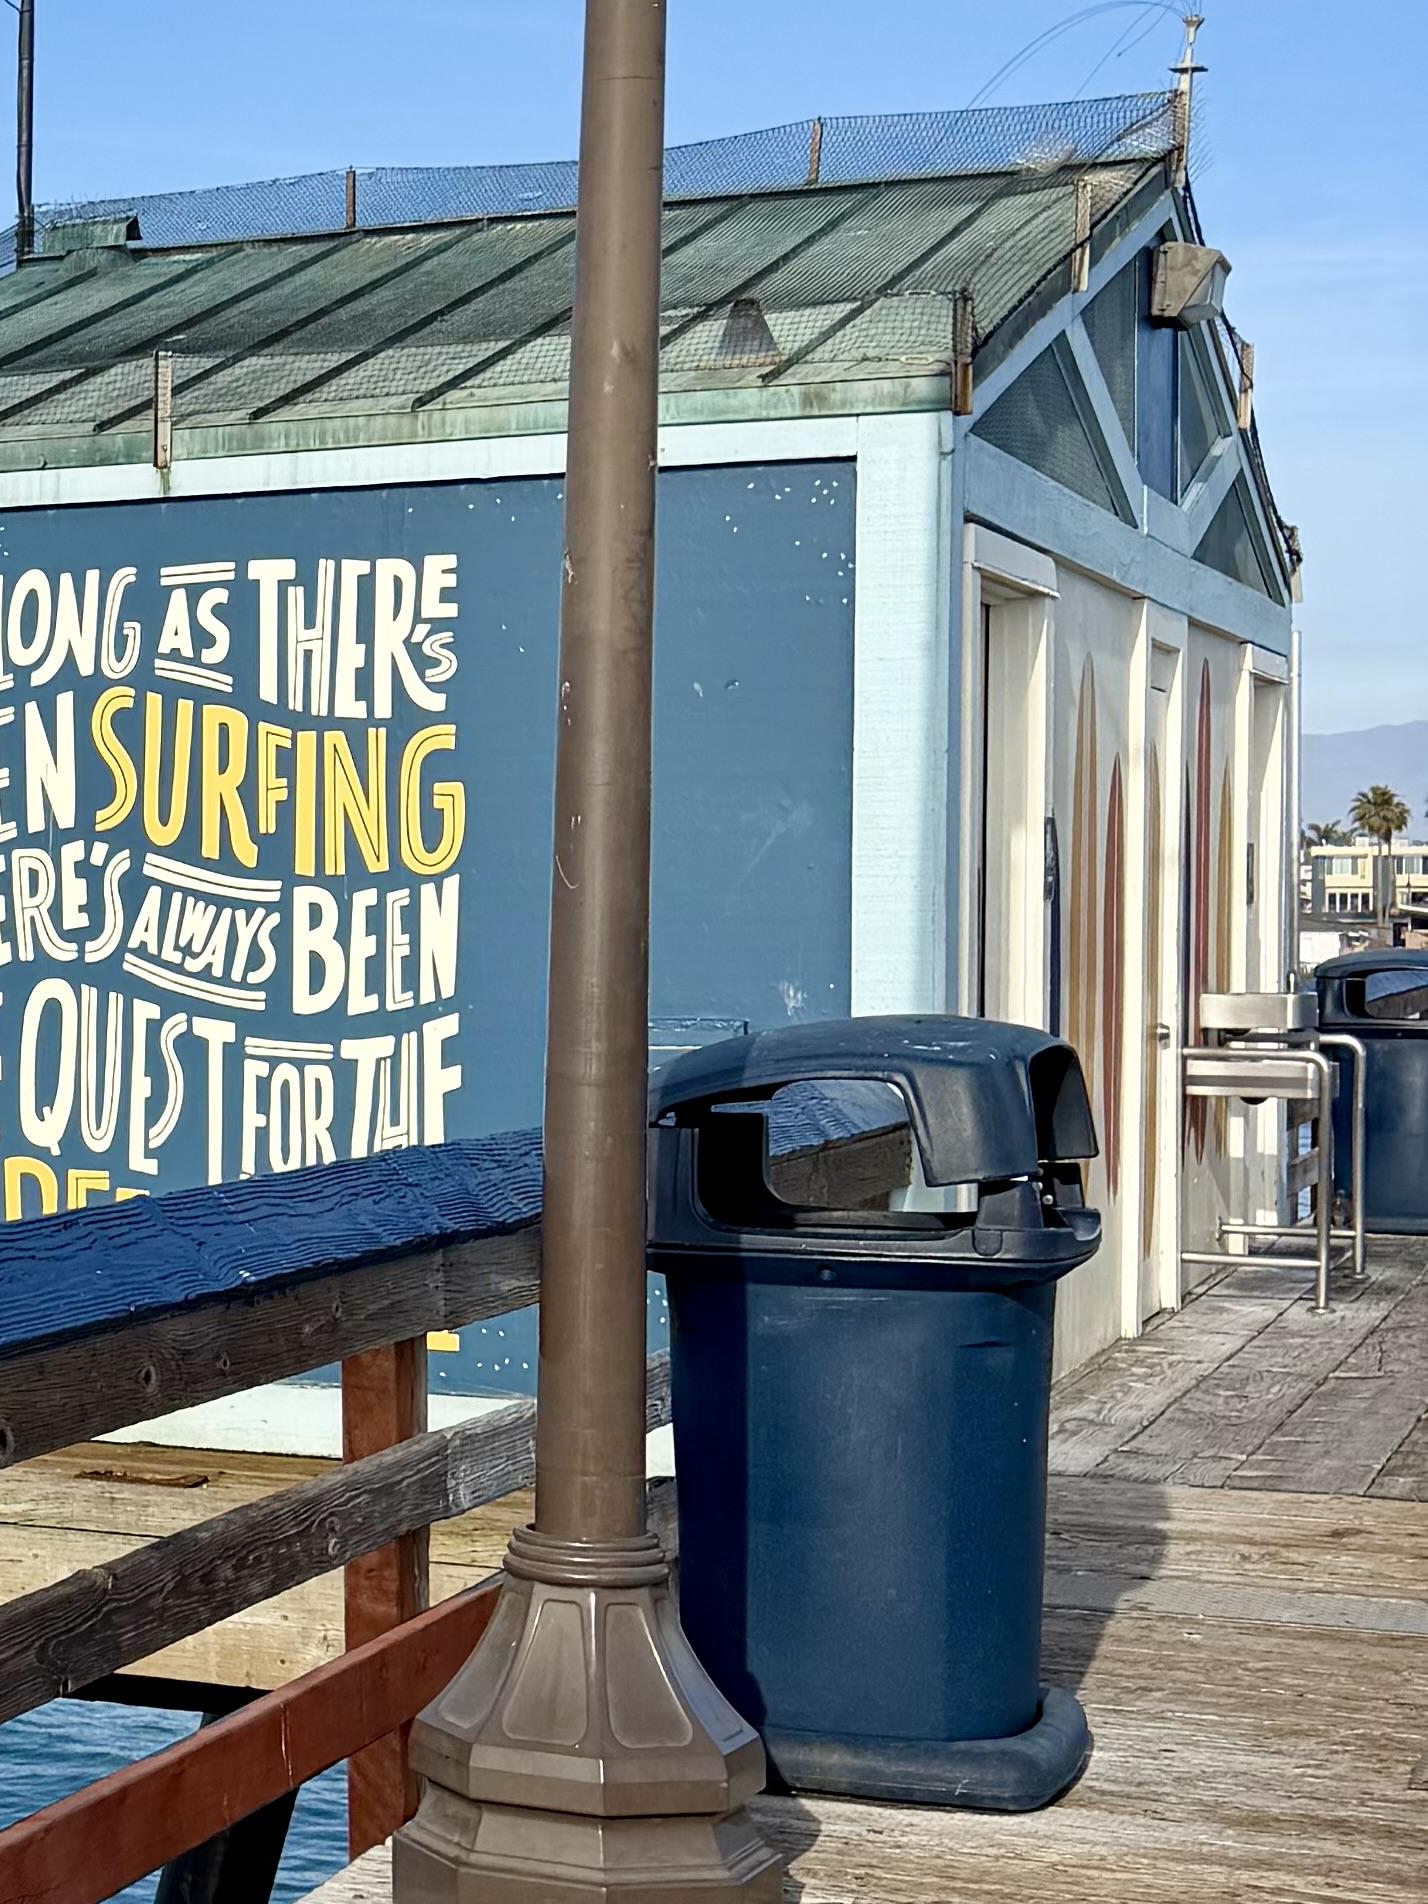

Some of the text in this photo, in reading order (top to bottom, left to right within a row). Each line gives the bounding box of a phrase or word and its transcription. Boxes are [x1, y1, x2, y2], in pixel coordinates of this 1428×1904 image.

[157, 587, 230, 664] AS
[247, 554, 459, 719] THERE'S
[91, 685, 466, 878] SURFING
[127, 885, 281, 984] ALWAYS
[292, 873, 460, 1016] BEEN
[19, 977, 236, 1186] QUEST
[241, 1058, 337, 1180] FOR
